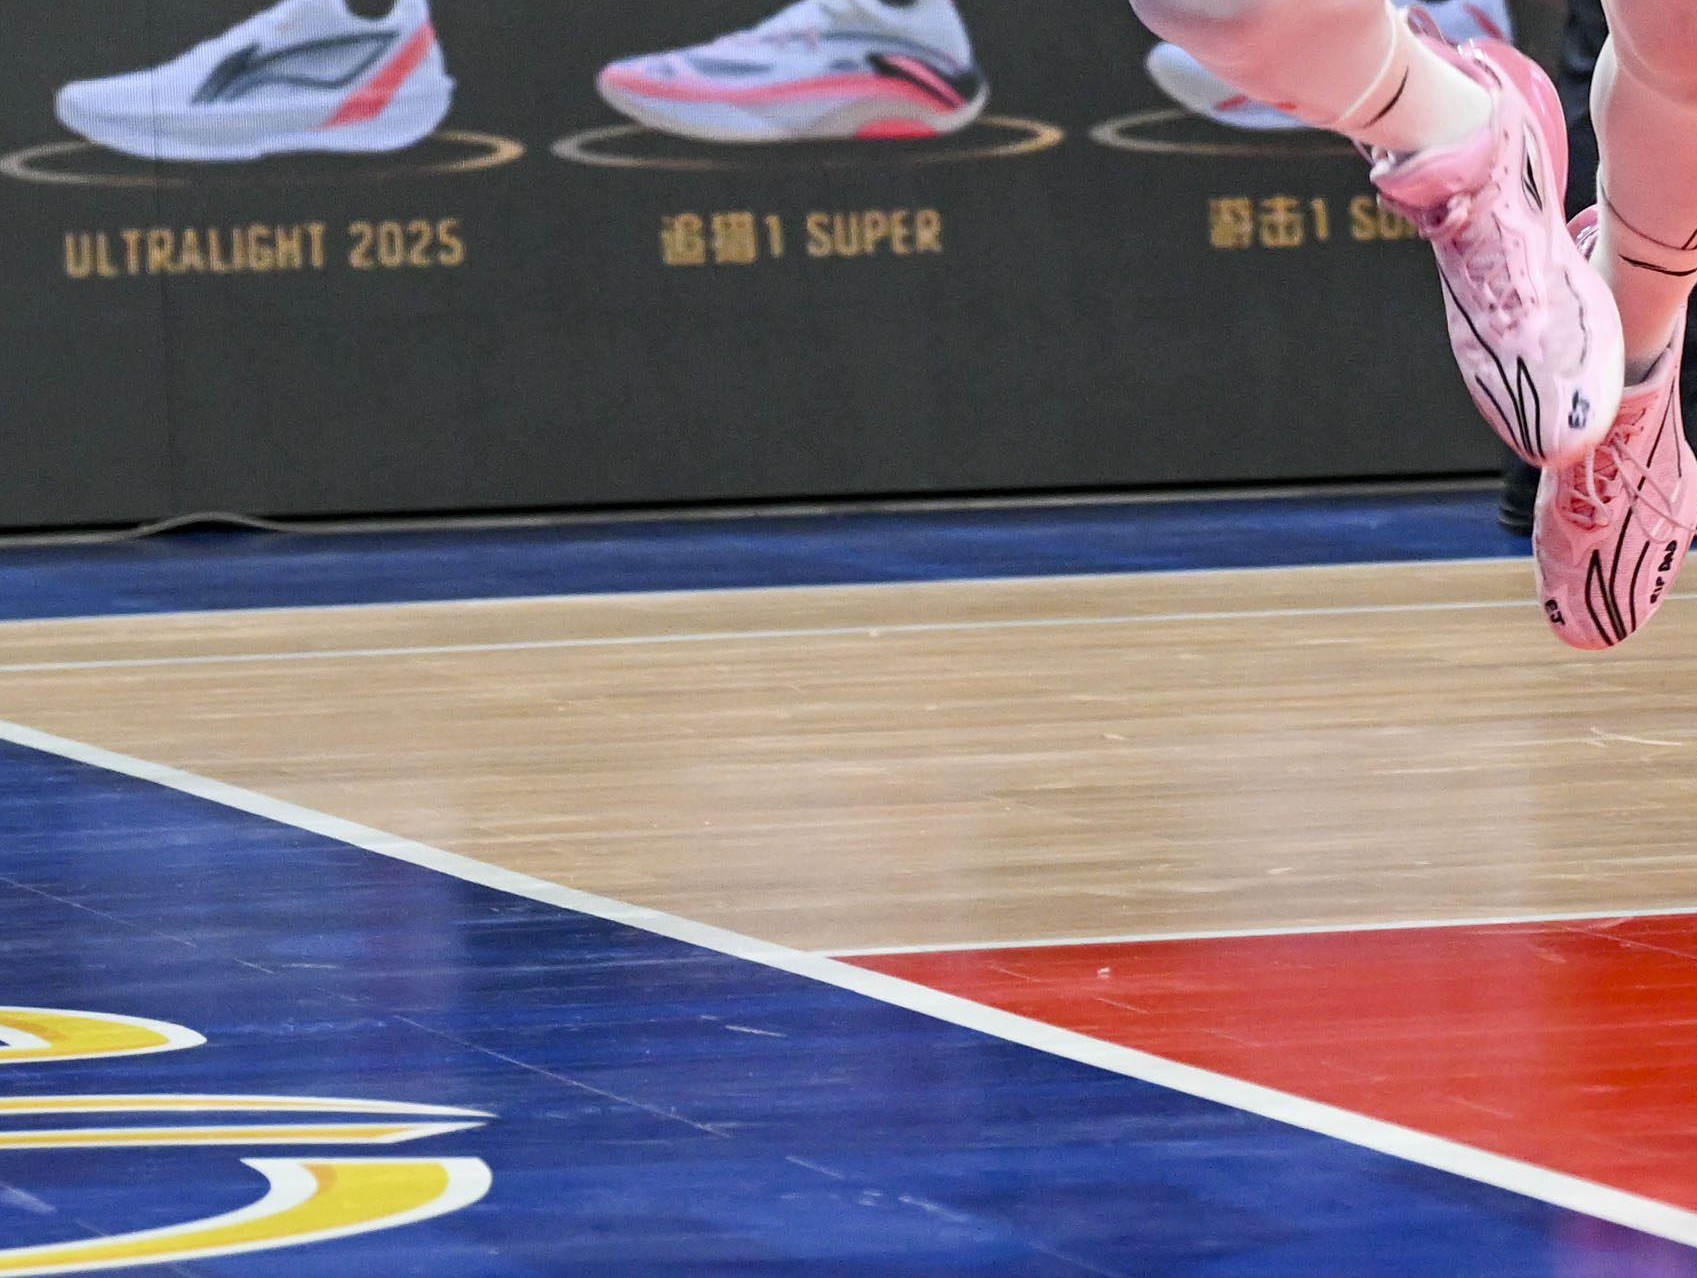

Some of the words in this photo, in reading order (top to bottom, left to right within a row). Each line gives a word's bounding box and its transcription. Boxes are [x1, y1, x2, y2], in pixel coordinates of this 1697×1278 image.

[64, 222, 327, 279] ULTRALIGHT
[347, 218, 467, 269] 2025
[806, 208, 943, 257] SUPER
